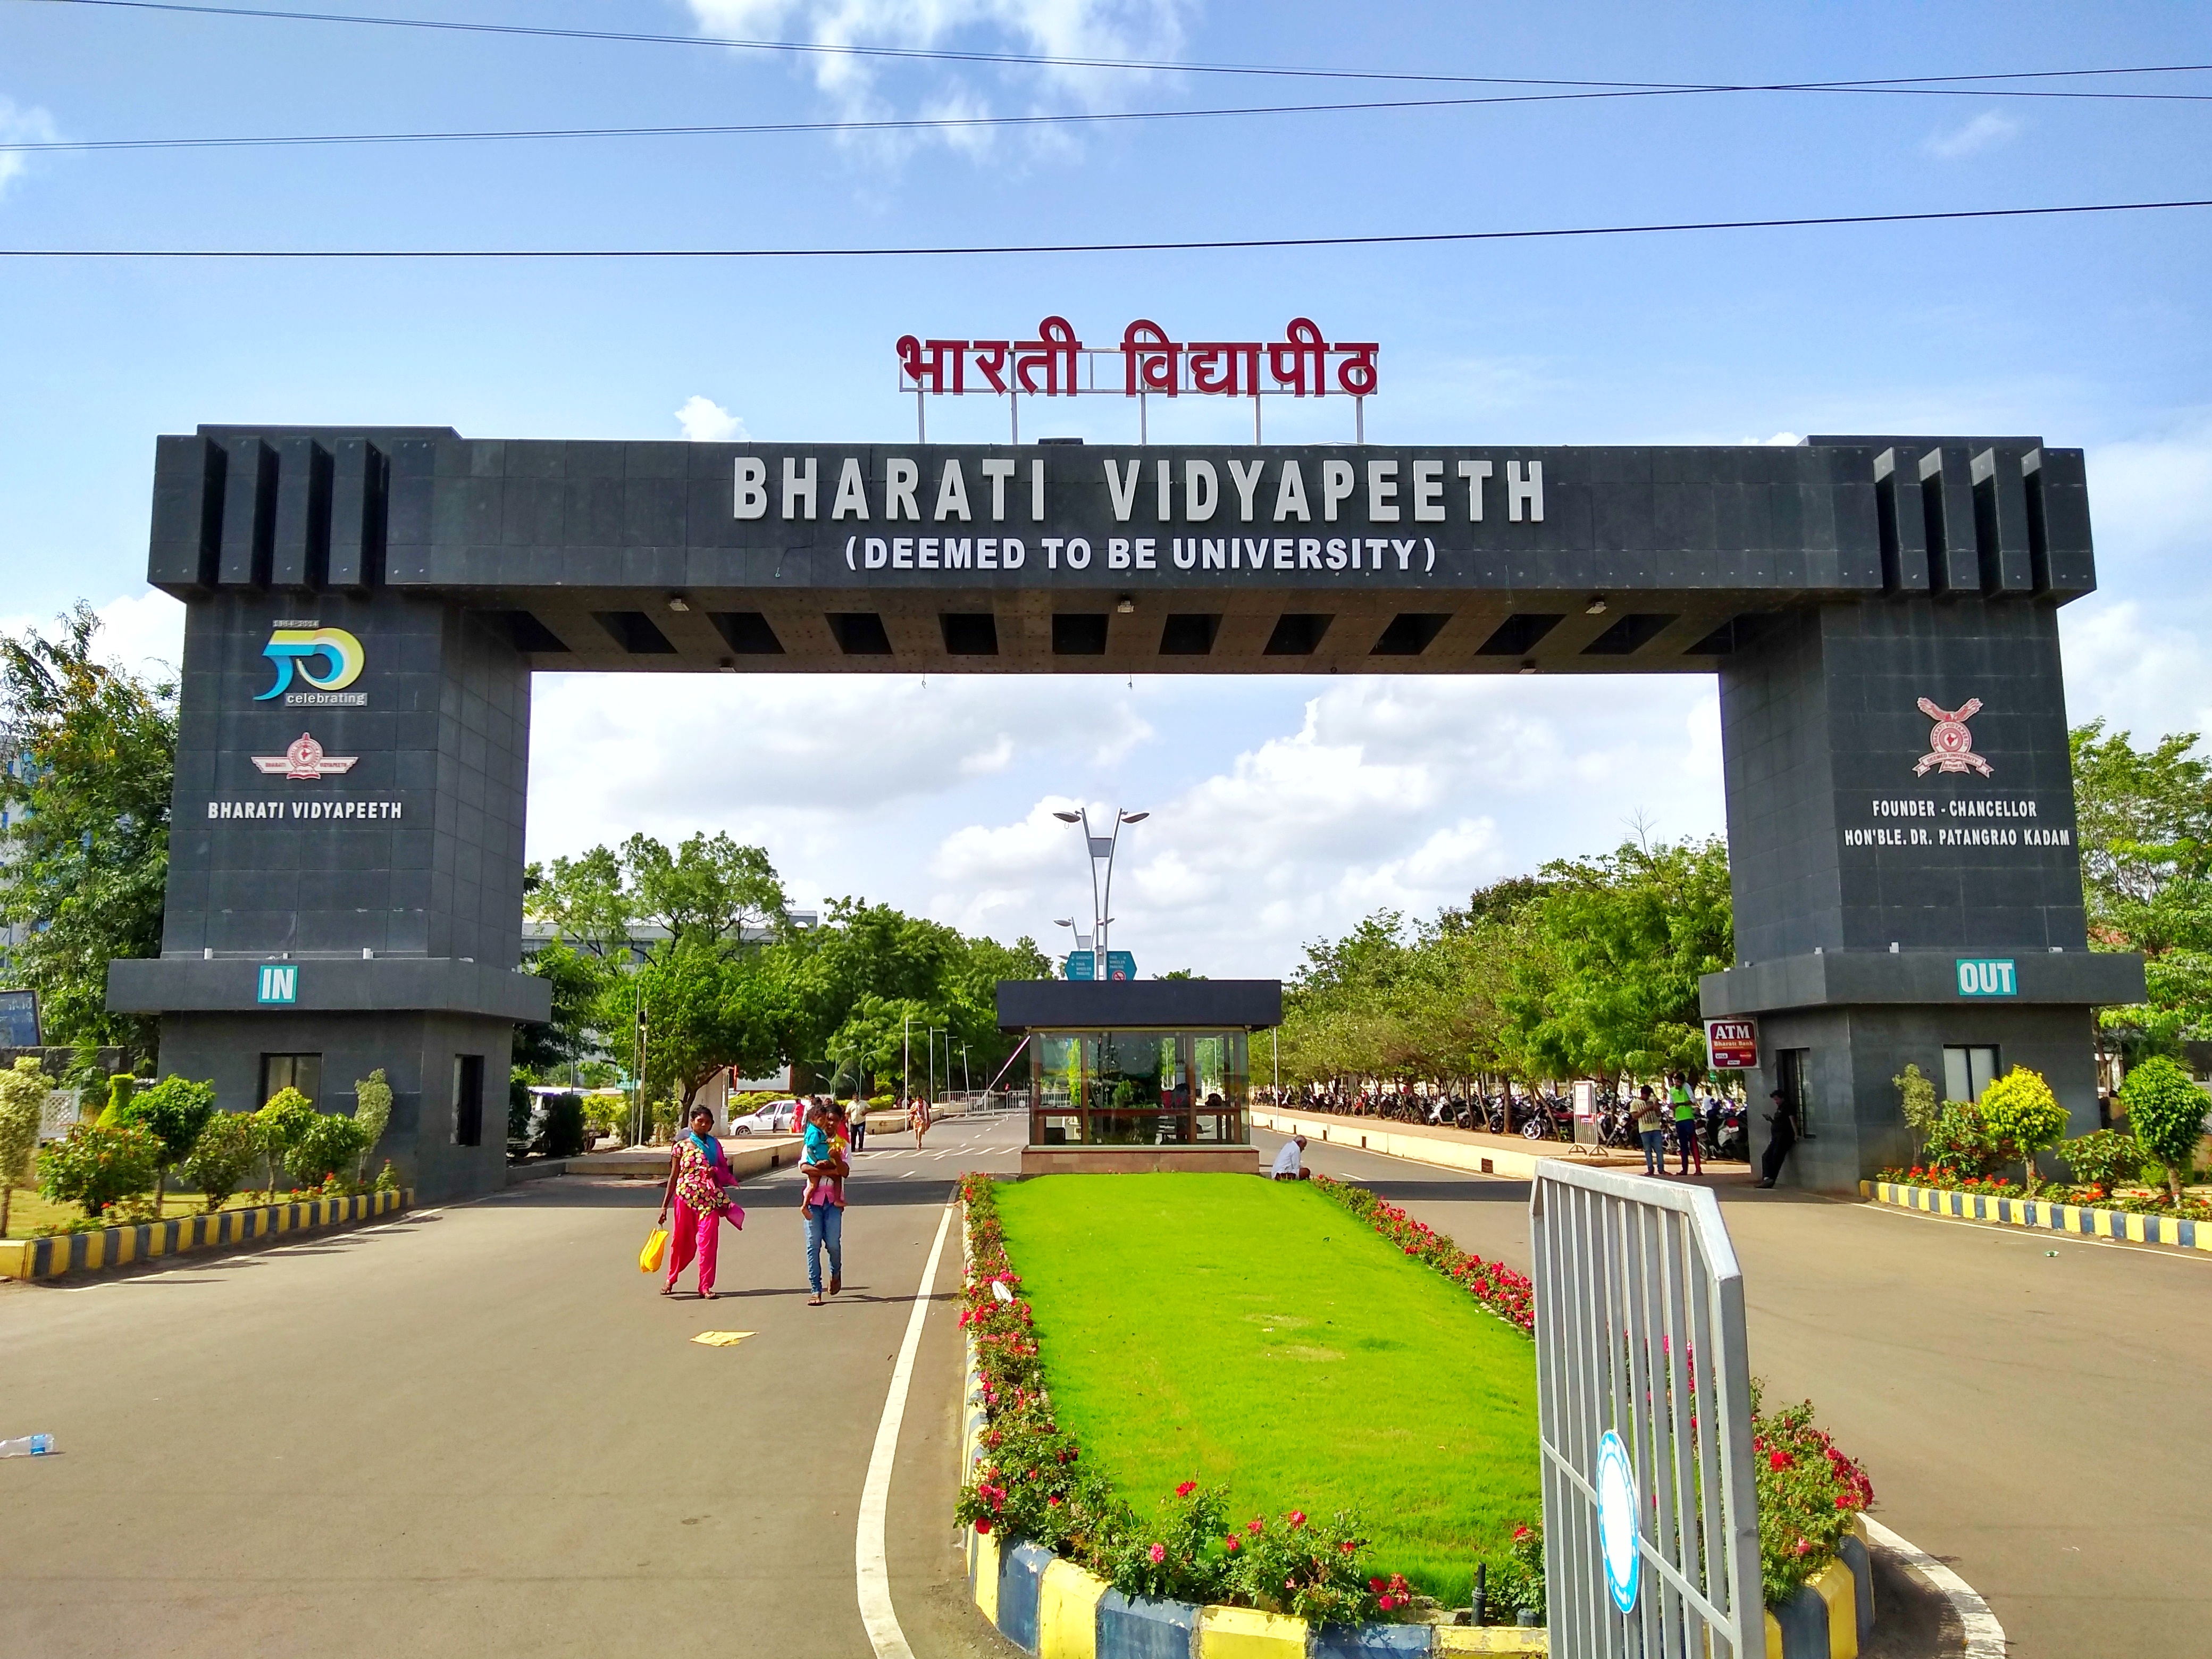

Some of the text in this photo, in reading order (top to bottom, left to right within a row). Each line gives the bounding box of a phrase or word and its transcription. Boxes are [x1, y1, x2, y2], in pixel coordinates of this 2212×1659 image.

[896, 315, 1379, 398] भारती विद्यापीठ
[733, 456, 1545, 522] BHARATI VIDYAPEETH
[845, 535, 1436, 572] (DEEMED TO BE UNIVERSITY)
[287, 693, 366, 705] celebrating
[1927, 753, 1979, 763] DEEMED UNIVERSITY
[207, 801, 402, 819] BHARATI VIDYAPEETH
[1872, 799, 1936, 817] FOUNDER
[1949, 800, 2038, 818] CHANCELLOR
[1938, 828, 2017, 846] PATANGRAO
[2023, 828, 2071, 846] KADAM
[261, 969, 294, 1000] IN
[1959, 962, 2013, 993] OUT
[1715, 1025, 1750, 1040] ATM
